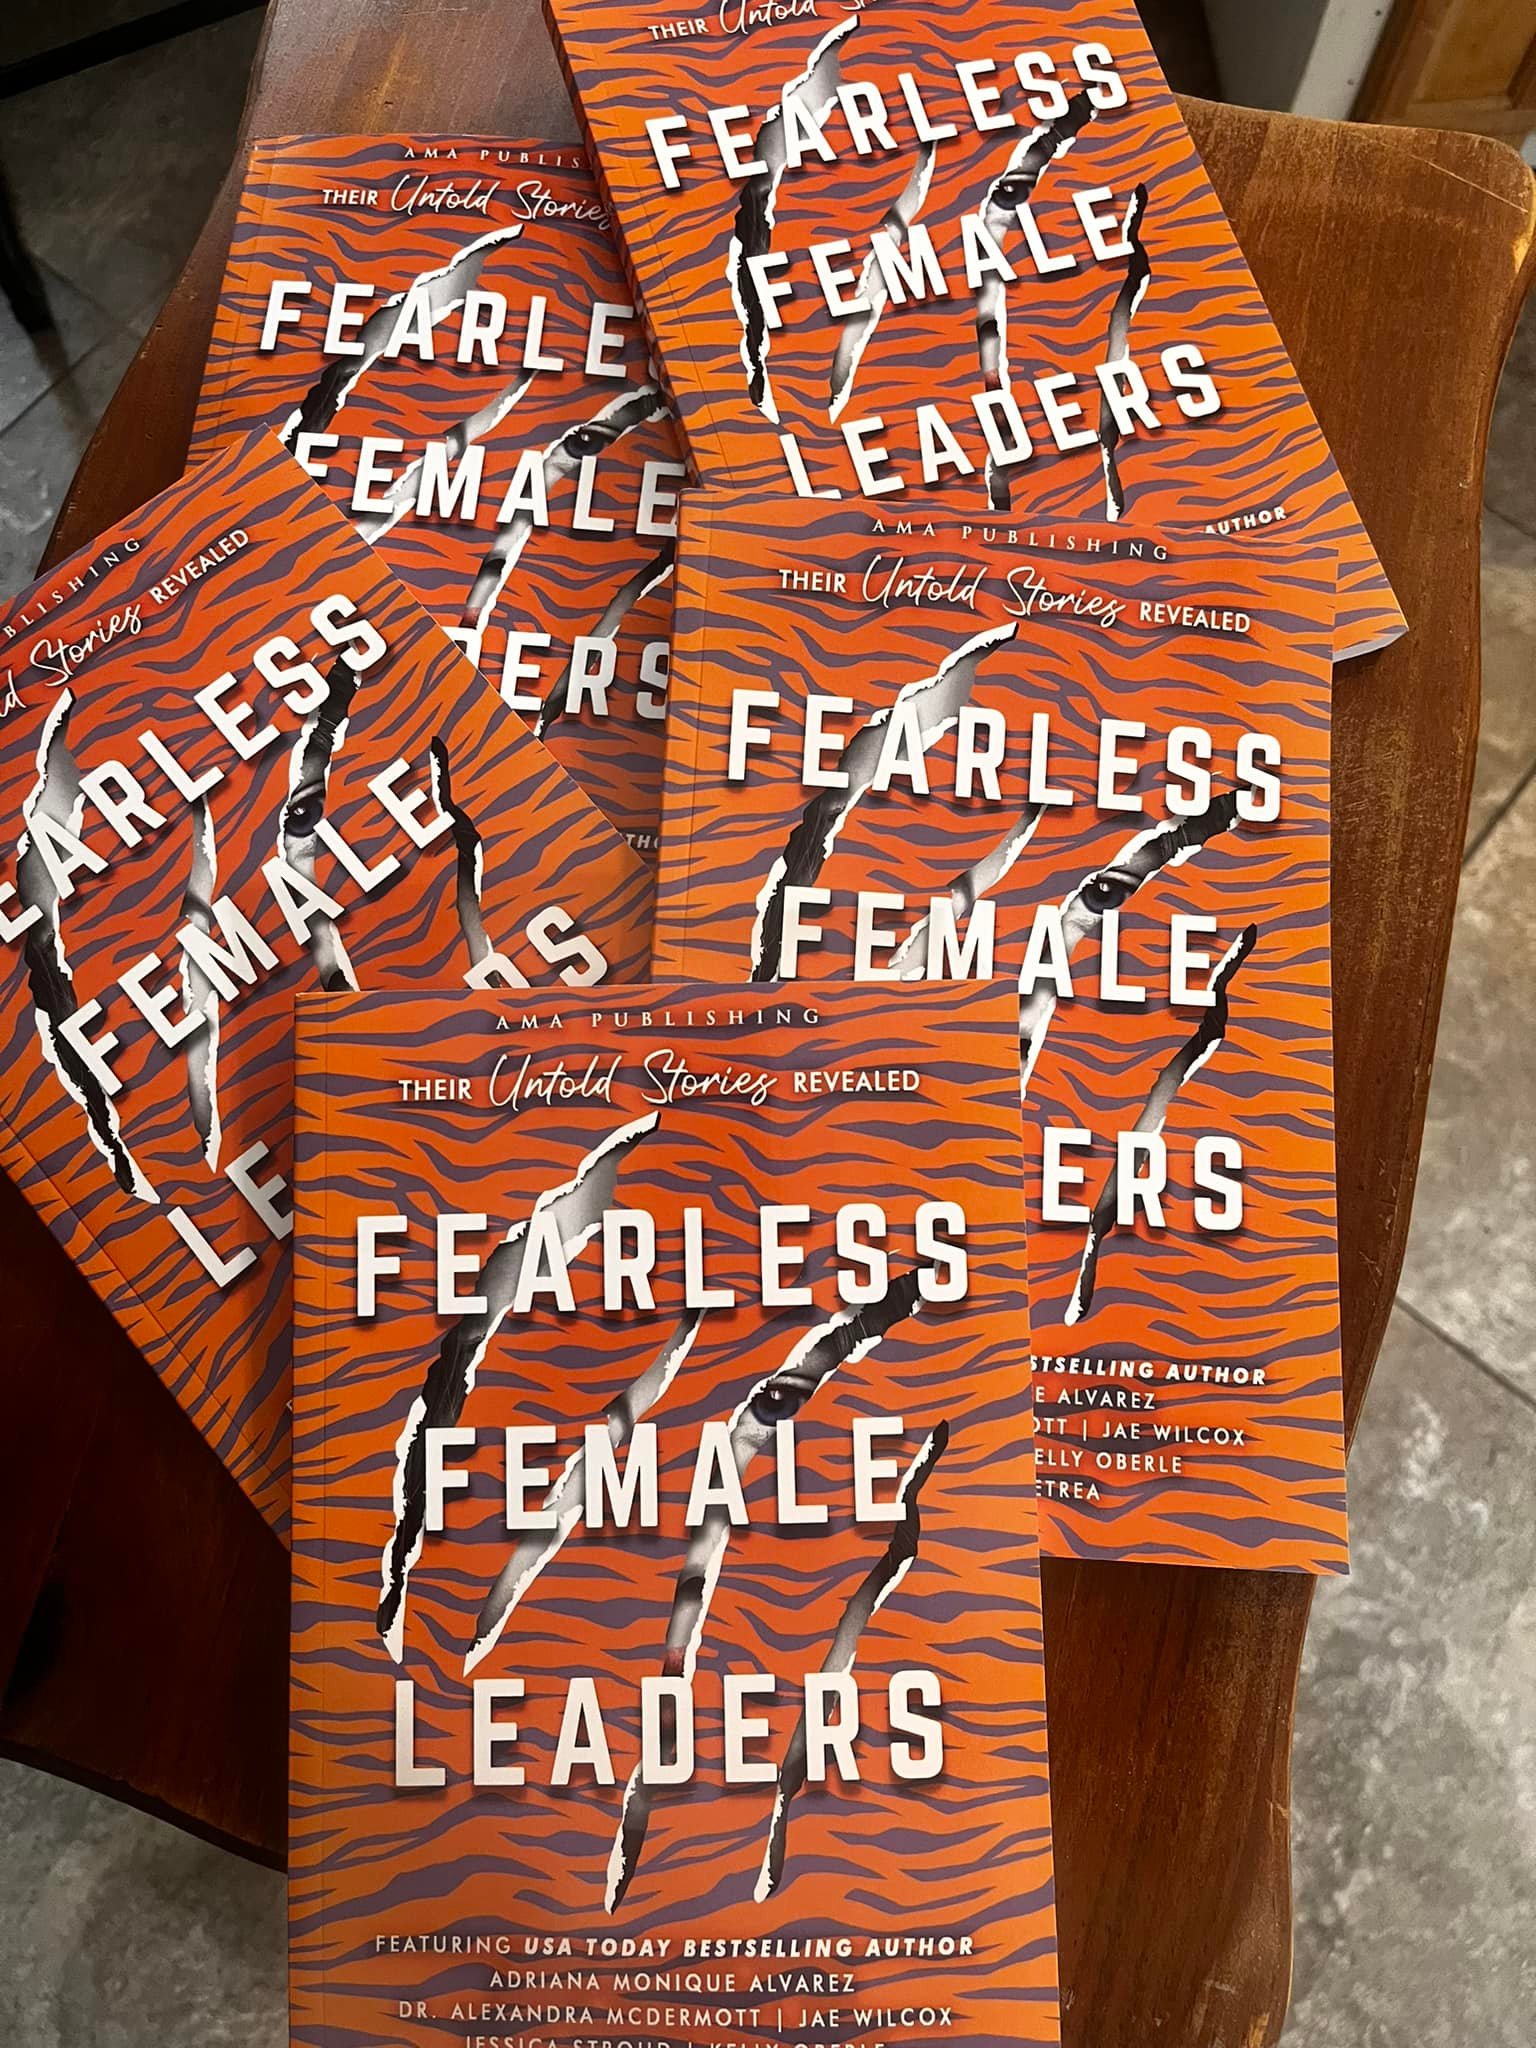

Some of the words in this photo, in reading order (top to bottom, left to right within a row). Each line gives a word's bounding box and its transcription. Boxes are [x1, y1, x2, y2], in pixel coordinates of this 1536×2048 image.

[648, 17, 708, 41] THEIR
[645, 42, 1128, 190] FEARLESS
[404, 147, 458, 161] AMA
[321, 188, 378, 206] THEIR
[390, 174, 500, 216] Untold
[746, 186, 1134, 329] FEMALE
[259, 279, 635, 379] FEARLE
[780, 343, 1222, 499] LEADERS
[872, 518, 936, 537] AMA
[962, 526, 1168, 561] PUBLISHING
[1205, 506, 1286, 535] AUTHOR
[30, 604, 142, 686] Stories
[149, 529, 249, 605] REVEALED
[778, 568, 848, 595] THEIR
[862, 554, 988, 610] Untold
[1002, 566, 1127, 628] Stories
[1138, 602, 1251, 634] REVEALED
[728, 688, 1282, 823] FEARLESS
[59, 757, 456, 1096] FEMALE
[779, 886, 1217, 1008] FEMALE
[496, 1013, 563, 1030] AMA
[592, 1007, 820, 1027] PUBLISHING
[399, 1079, 473, 1101] THEIR
[489, 1053, 623, 1112] Untold
[641, 1047, 778, 1106] Stories
[793, 1069, 920, 1094] REVEALED
[355, 1201, 969, 1318] FEARLESS
[1058, 1388, 1156, 1410] ALVAREZ
[1166, 1363, 1266, 1385] AUTHOR
[1102, 1421, 1140, 1440] JAE
[1153, 1424, 1245, 1447] WILCOX
[424, 1416, 907, 1532] FEMALE
[1096, 1452, 1183, 1474] OBERLE
[394, 1669, 944, 1788] LEADERS
[376, 1935, 511, 1955] FEATURING
[524, 1937, 573, 1955] USA
[585, 1938, 672, 1957] TODAY
[683, 1938, 852, 1958] BESTSELLING
[865, 1936, 974, 1957] AUTHOR
[490, 1970, 601, 1990] ADRIANA
[613, 1972, 736, 1993] MONIQUE
[750, 1973, 855, 1993] ALVAREZ
[400, 2000, 437, 2019] DR.
[451, 2002, 594, 2024] ALEXANDRA
[606, 2007, 761, 2027] MCDERMOTT
[799, 2008, 840, 2028] JAE
[853, 2007, 953, 2027] WILCOX
